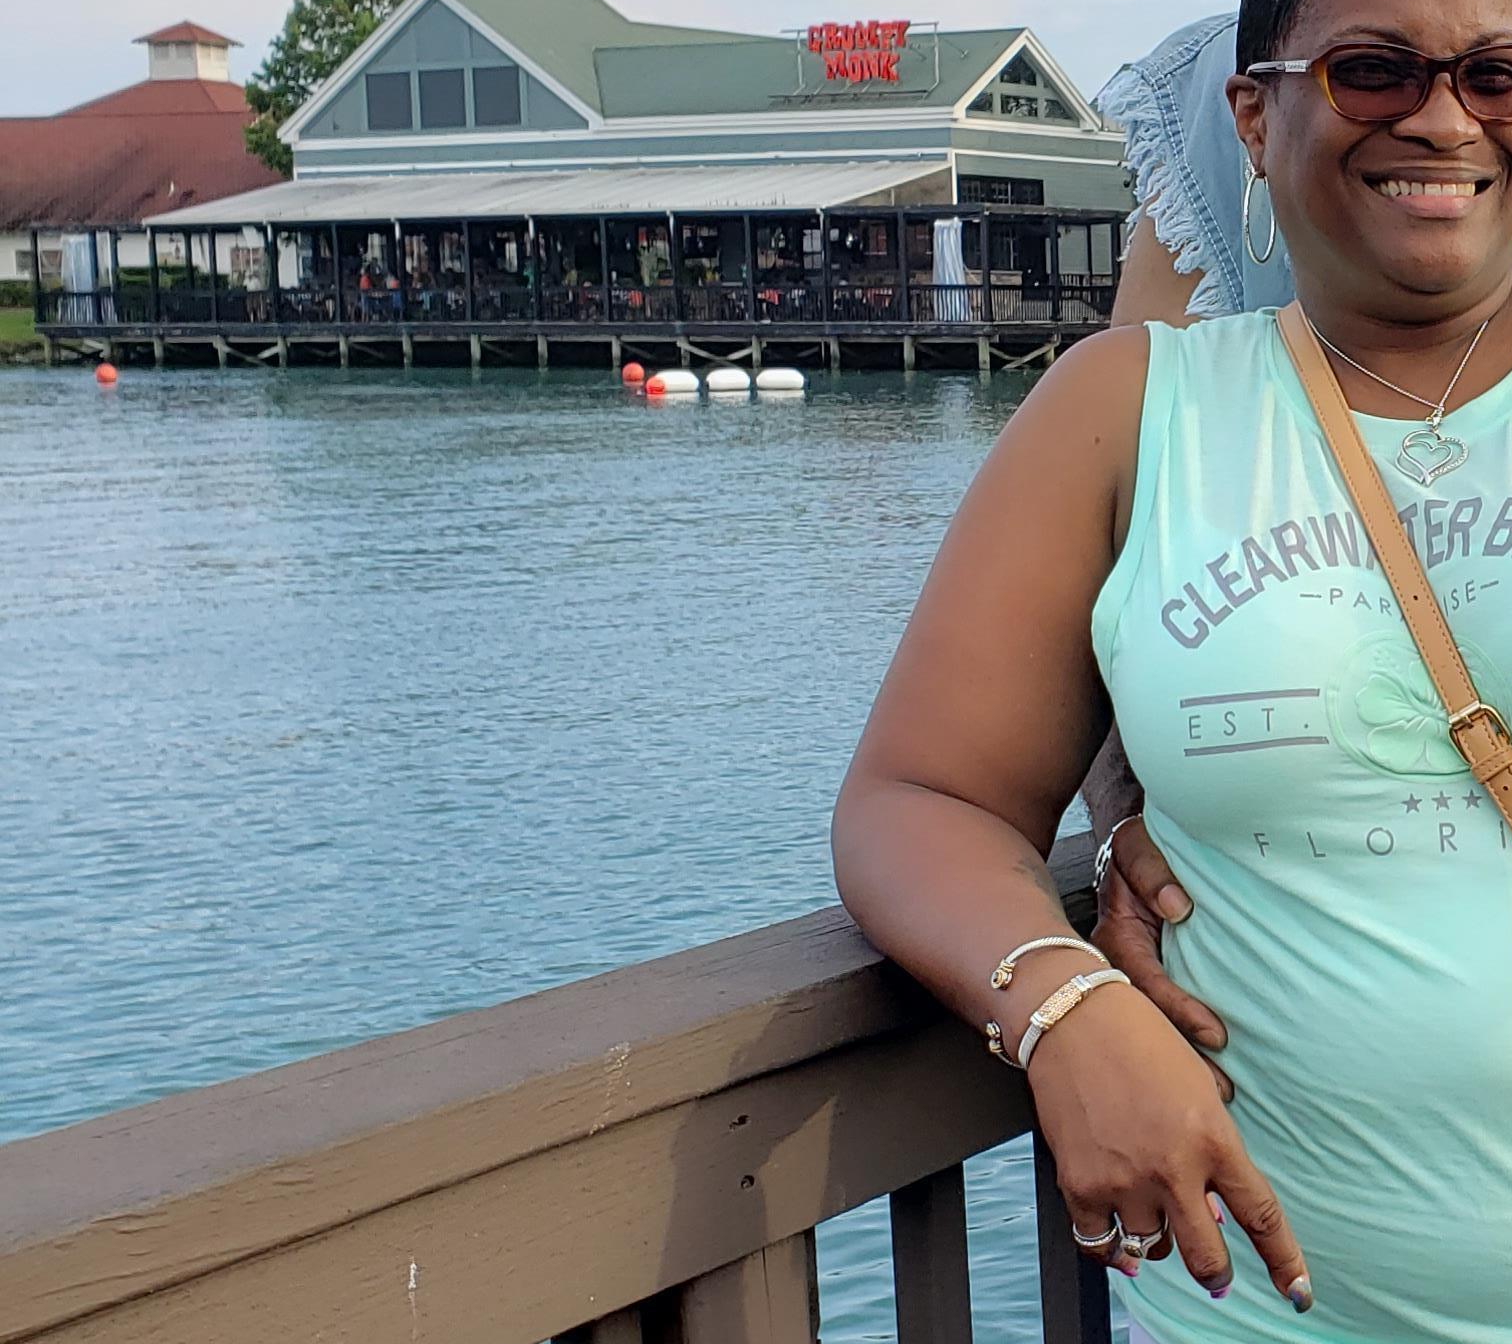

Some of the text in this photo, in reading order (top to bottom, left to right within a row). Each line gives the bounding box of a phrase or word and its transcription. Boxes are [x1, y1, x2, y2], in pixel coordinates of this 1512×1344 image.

[808, 19, 911, 53] GRUMPY
[823, 50, 900, 83] MONK
[1329, 580, 1477, 619] PARISE
[1189, 707, 1310, 740] EST.
